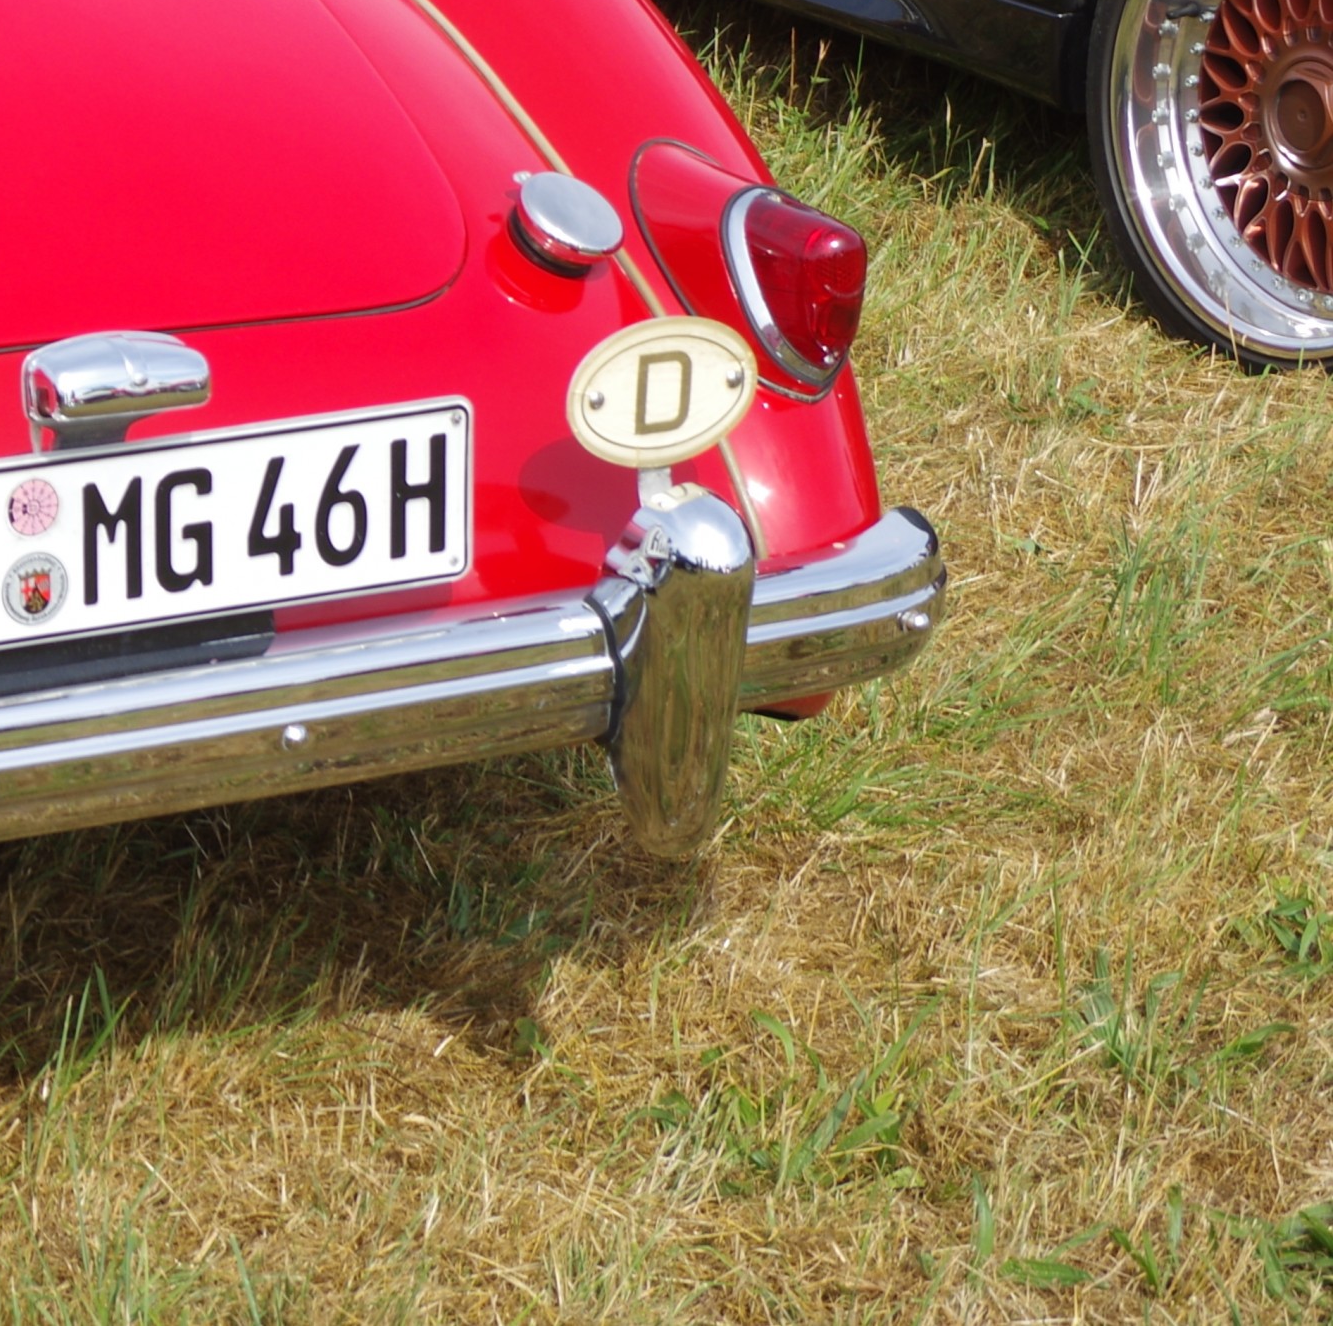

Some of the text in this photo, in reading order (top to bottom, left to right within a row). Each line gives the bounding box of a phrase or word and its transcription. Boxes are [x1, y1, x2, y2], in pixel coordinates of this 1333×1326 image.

[633, 349, 693, 436] D
[81, 466, 214, 607] MG
[247, 432, 448, 577] 46H
